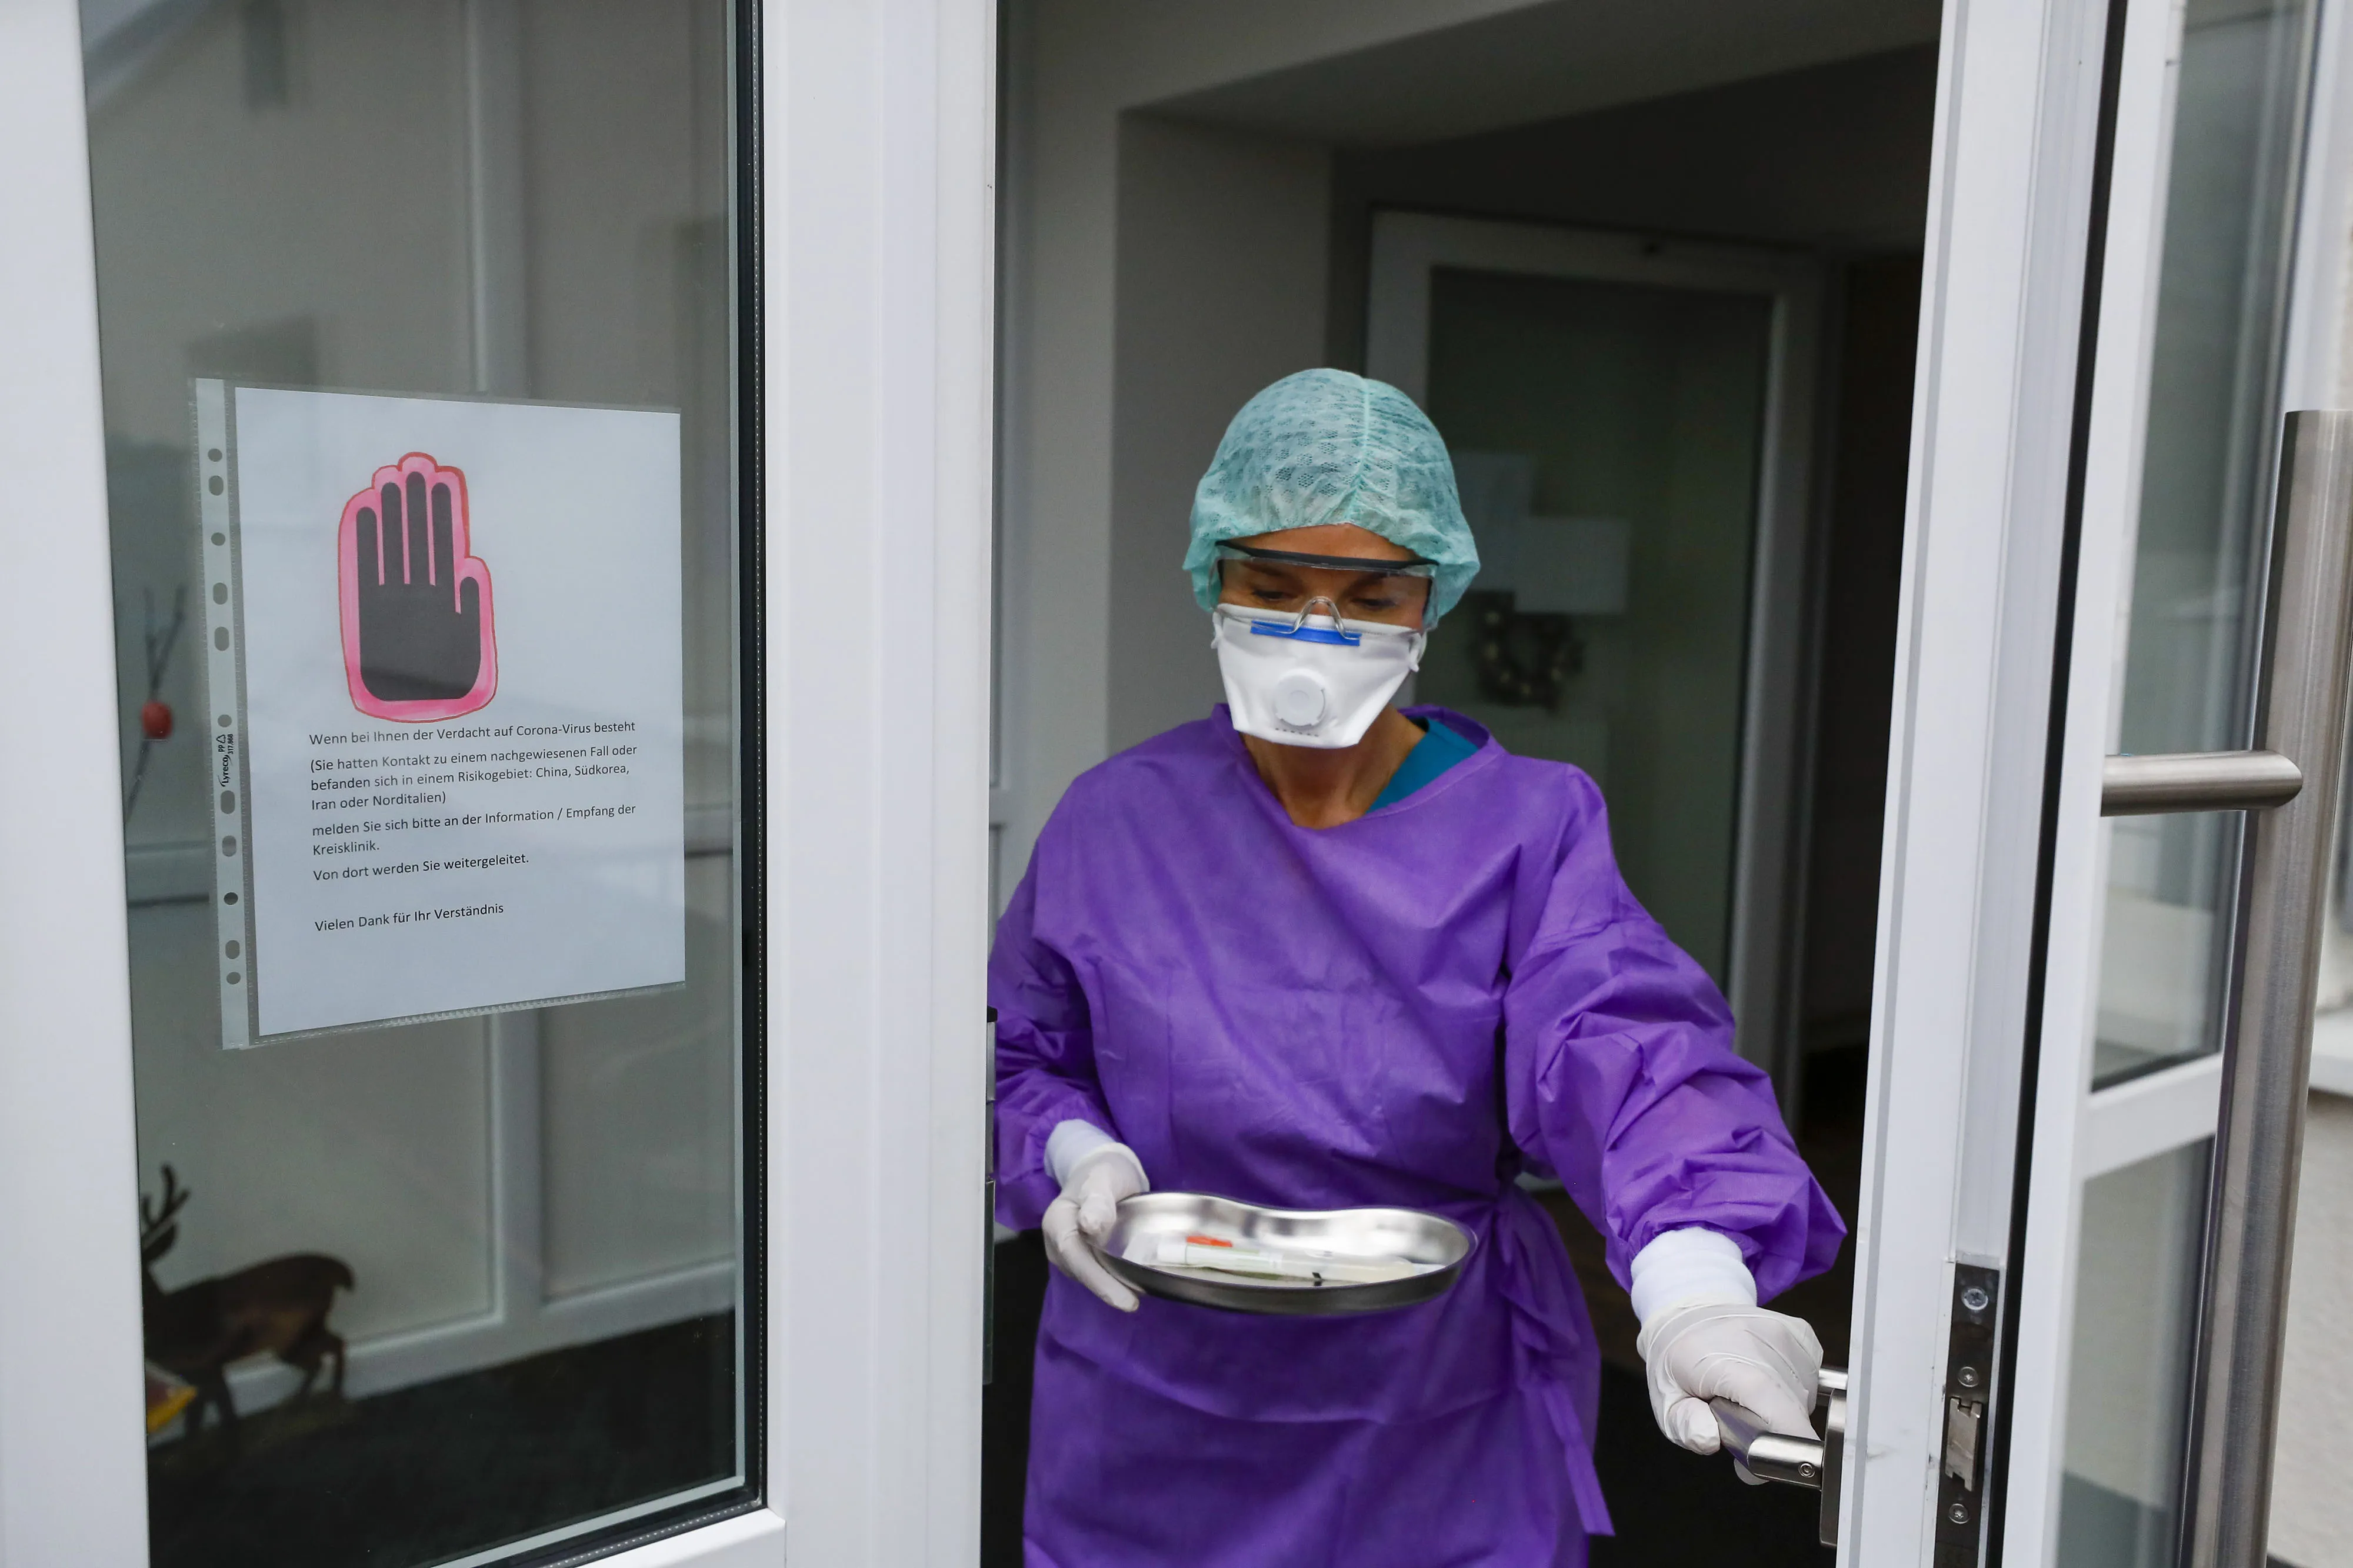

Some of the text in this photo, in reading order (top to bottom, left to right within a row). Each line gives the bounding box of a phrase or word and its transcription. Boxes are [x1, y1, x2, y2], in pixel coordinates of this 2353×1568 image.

[309, 720, 636, 745] Wenn bei Ihnen der Verdacht auf Corona-Virus besteht
[221, 756, 231, 784] Lyreco
[311, 745, 638, 773] (Sie hatten Kontakt zu einem nachgewiesenen Fall oder
[311, 764, 629, 791] befanden sich in einem Risikogebiet: China, Südkorea,
[312, 790, 446, 810] Iran oder Norditalien)
[312, 804, 636, 836] melden Sie sich bitte an der Information / Empfang der
[313, 839, 380, 856] Kreisklinik.
[312, 853, 529, 881] Von dort werden Sie weitergeleitet.
[314, 903, 504, 932] Vielen Dank für Ihr Verständnis
